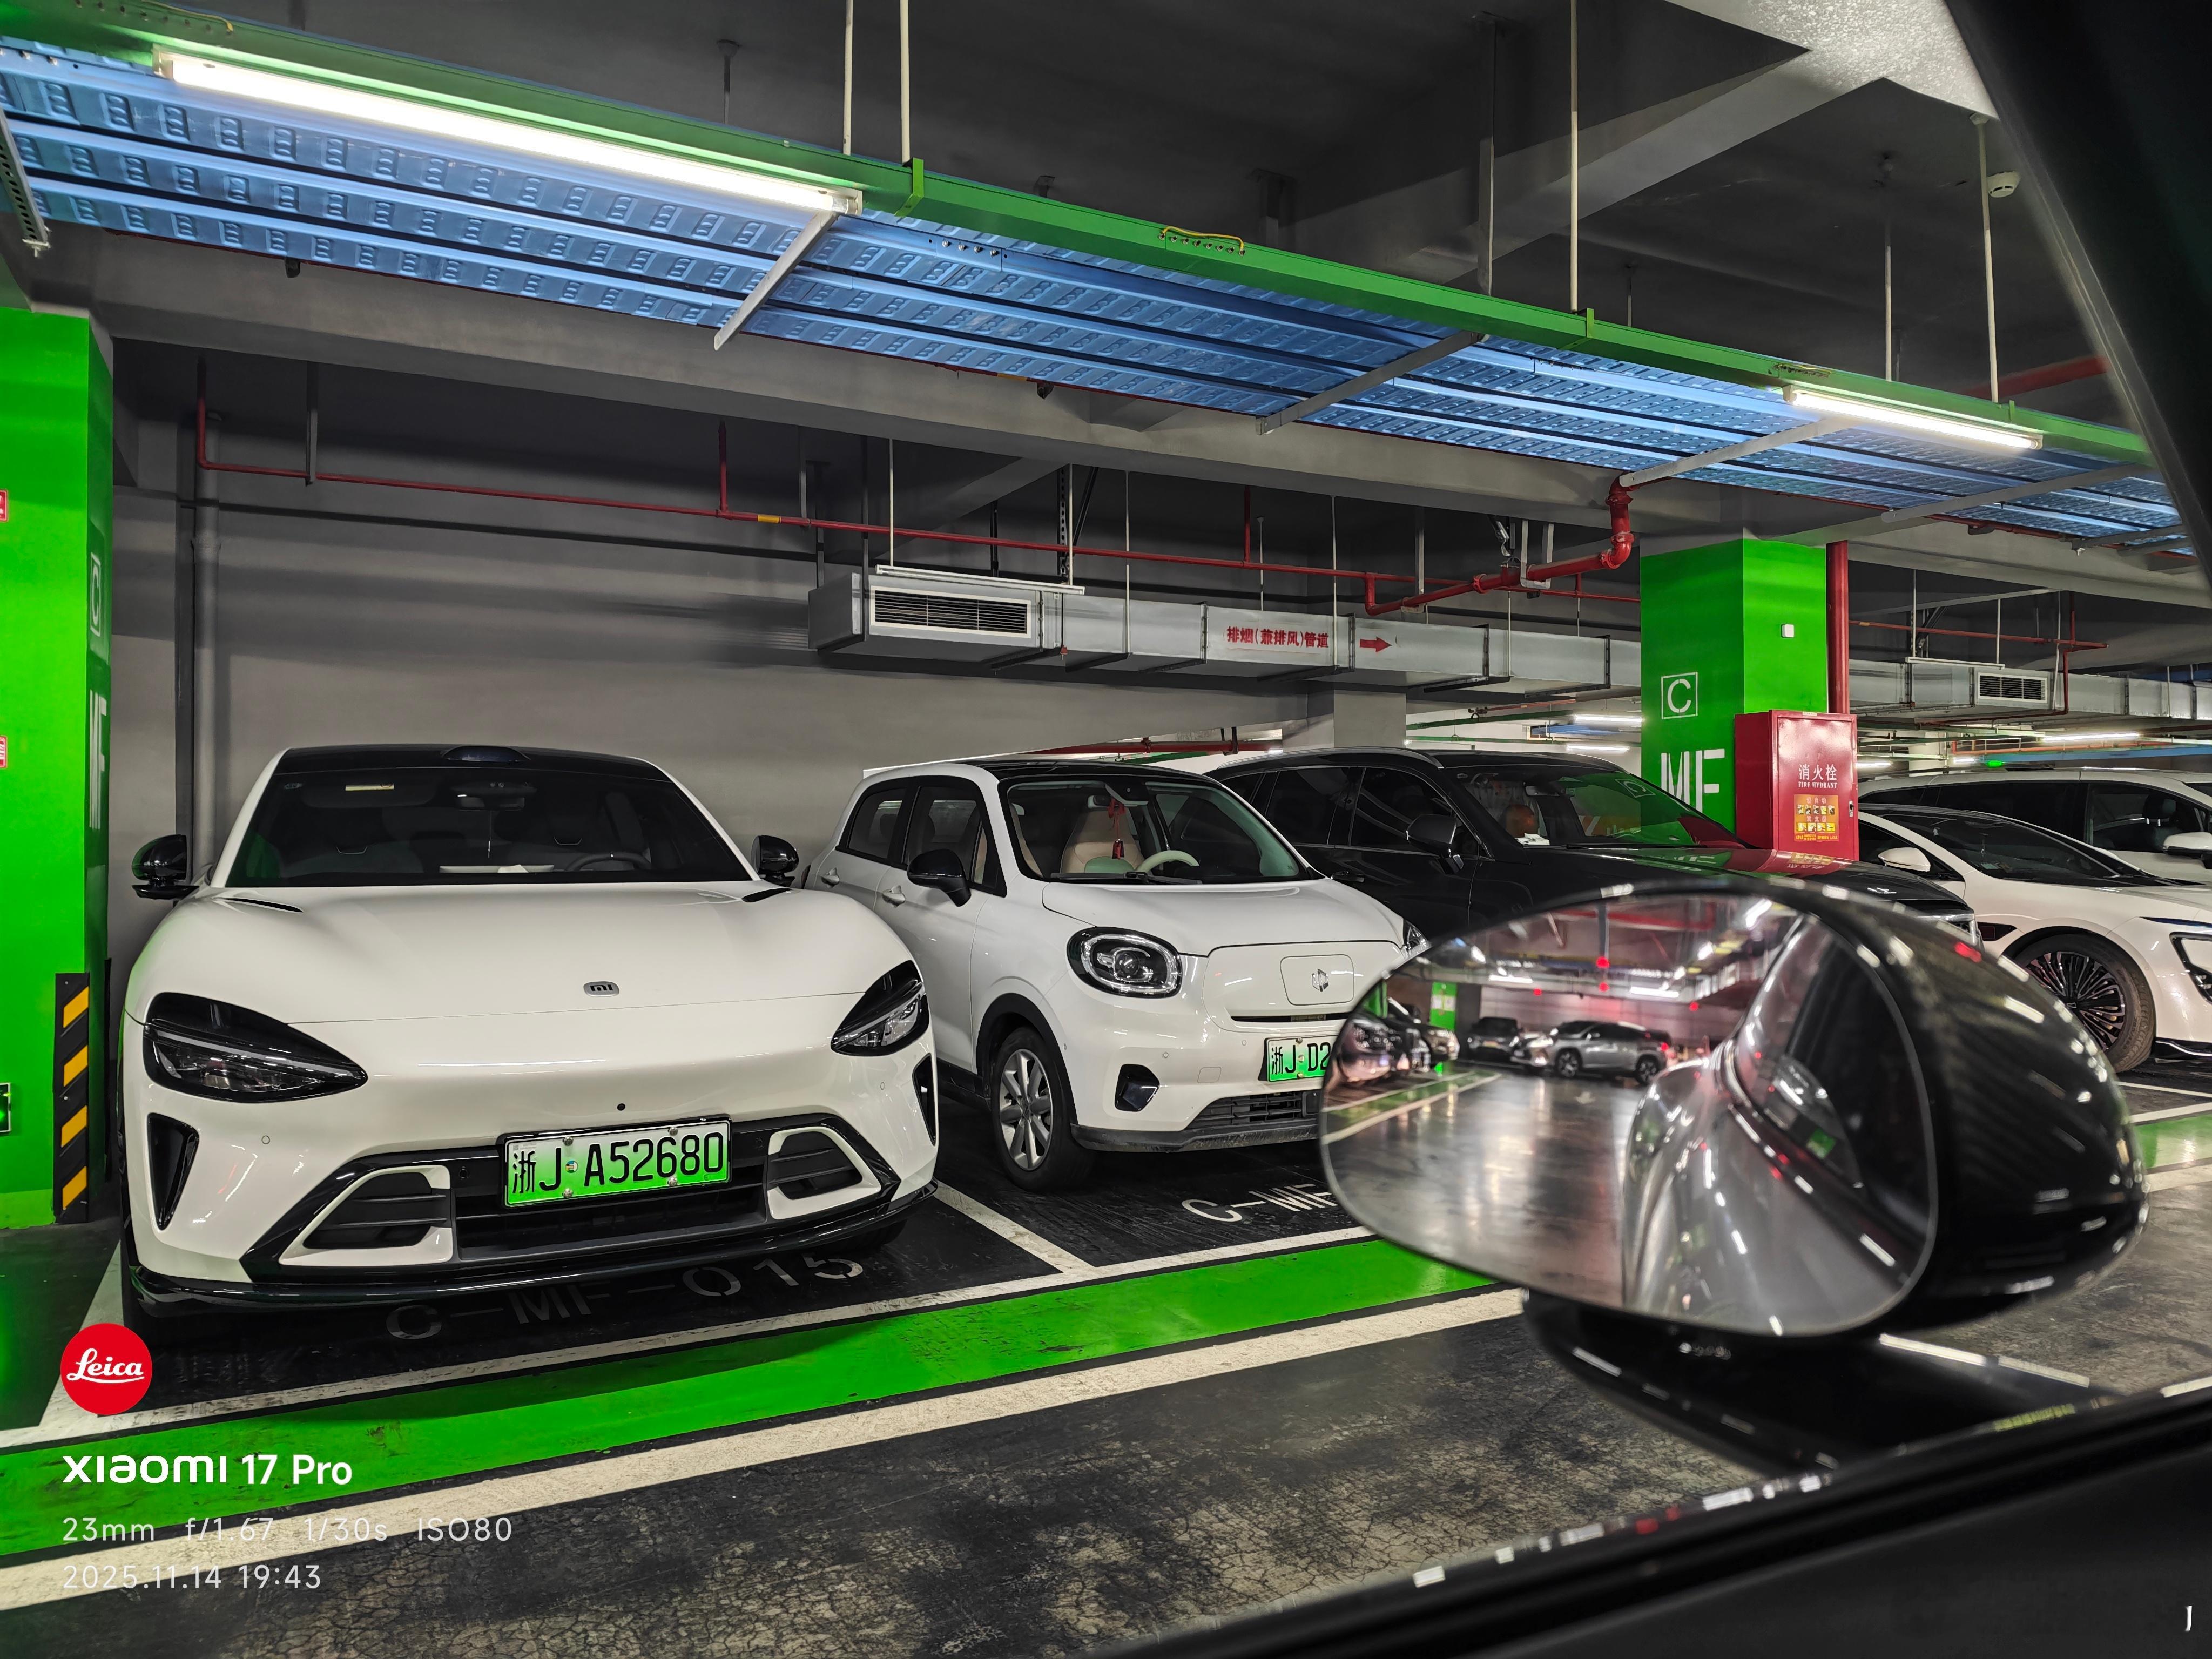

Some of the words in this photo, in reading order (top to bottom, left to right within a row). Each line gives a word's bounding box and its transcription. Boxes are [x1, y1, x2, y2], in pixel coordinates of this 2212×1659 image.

[1667, 678, 1692, 713] C
[1661, 748, 1725, 813] MF
[1799, 764, 1837, 781] 消火栓
